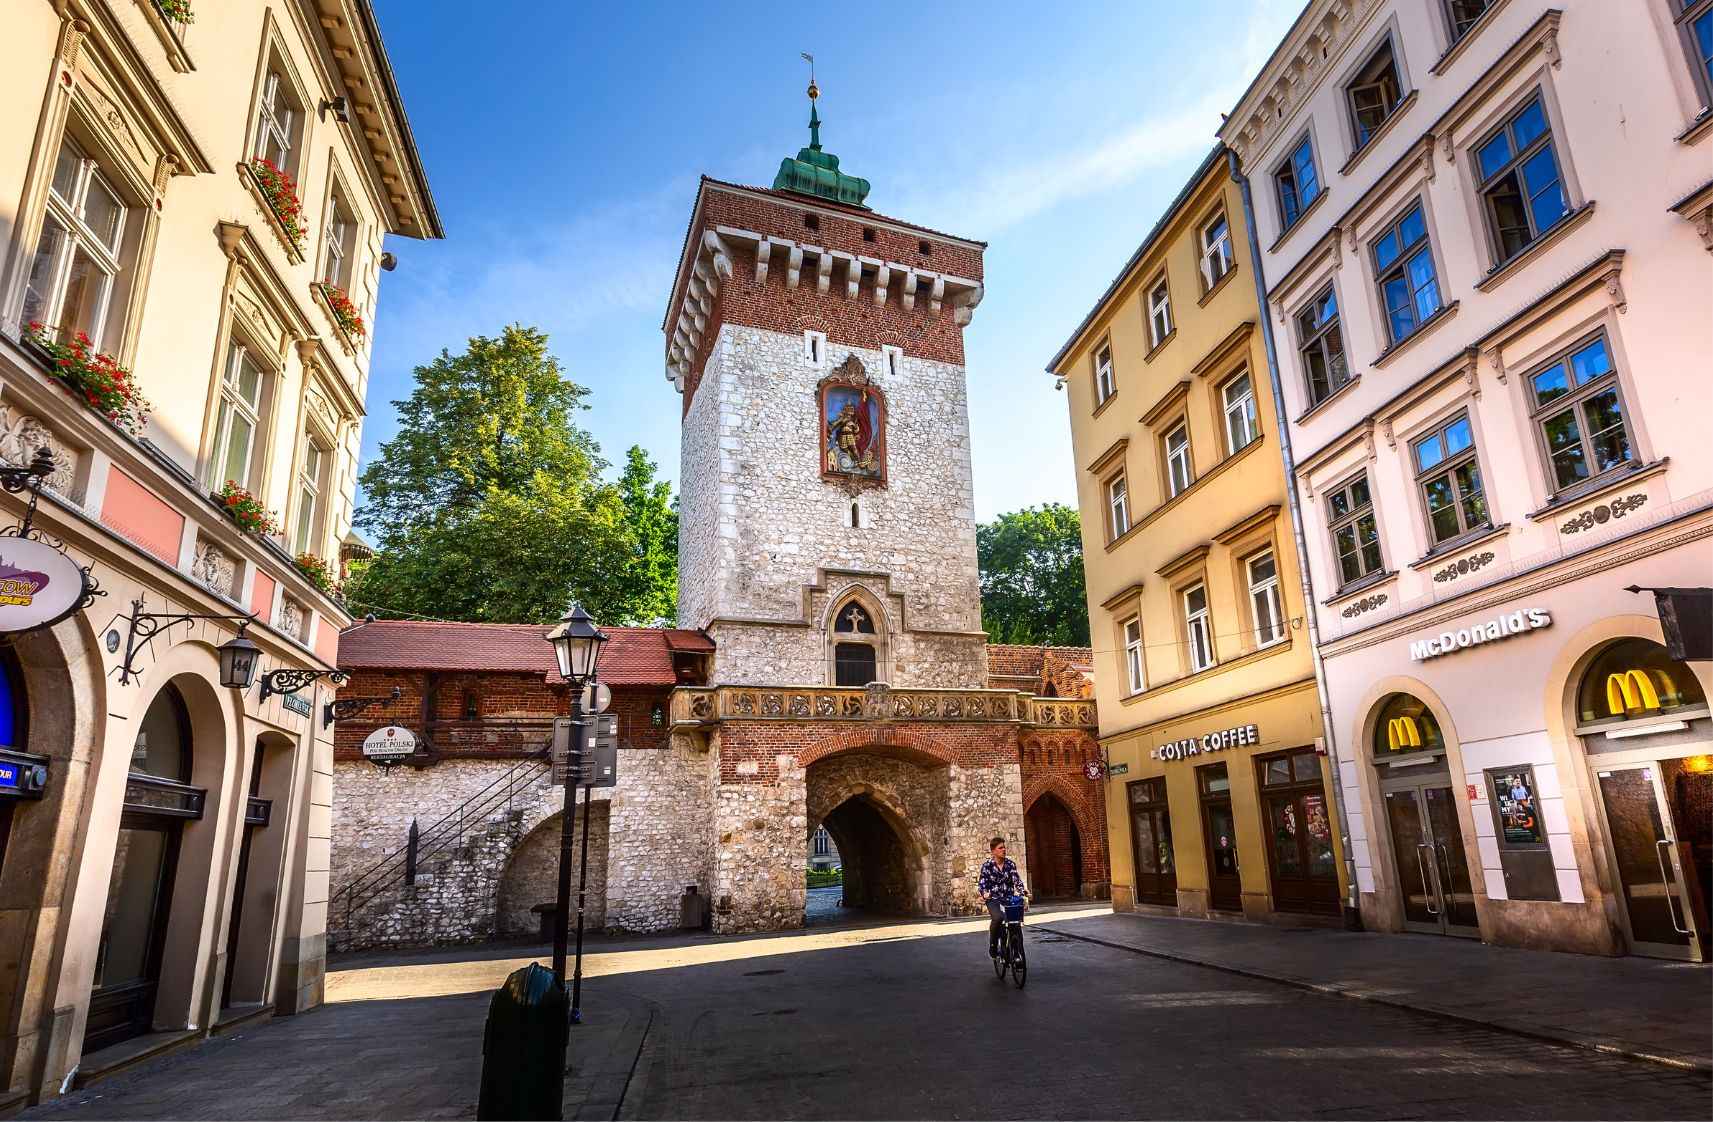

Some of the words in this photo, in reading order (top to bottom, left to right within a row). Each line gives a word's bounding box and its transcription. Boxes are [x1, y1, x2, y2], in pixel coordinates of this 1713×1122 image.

[1409, 607, 1552, 662] McDonald's
[364, 741, 387, 749] HOTEL
[389, 740, 414, 748] POLSKI
[1159, 739, 1200, 761] COSTA
[1202, 725, 1258, 752] COFFEE
